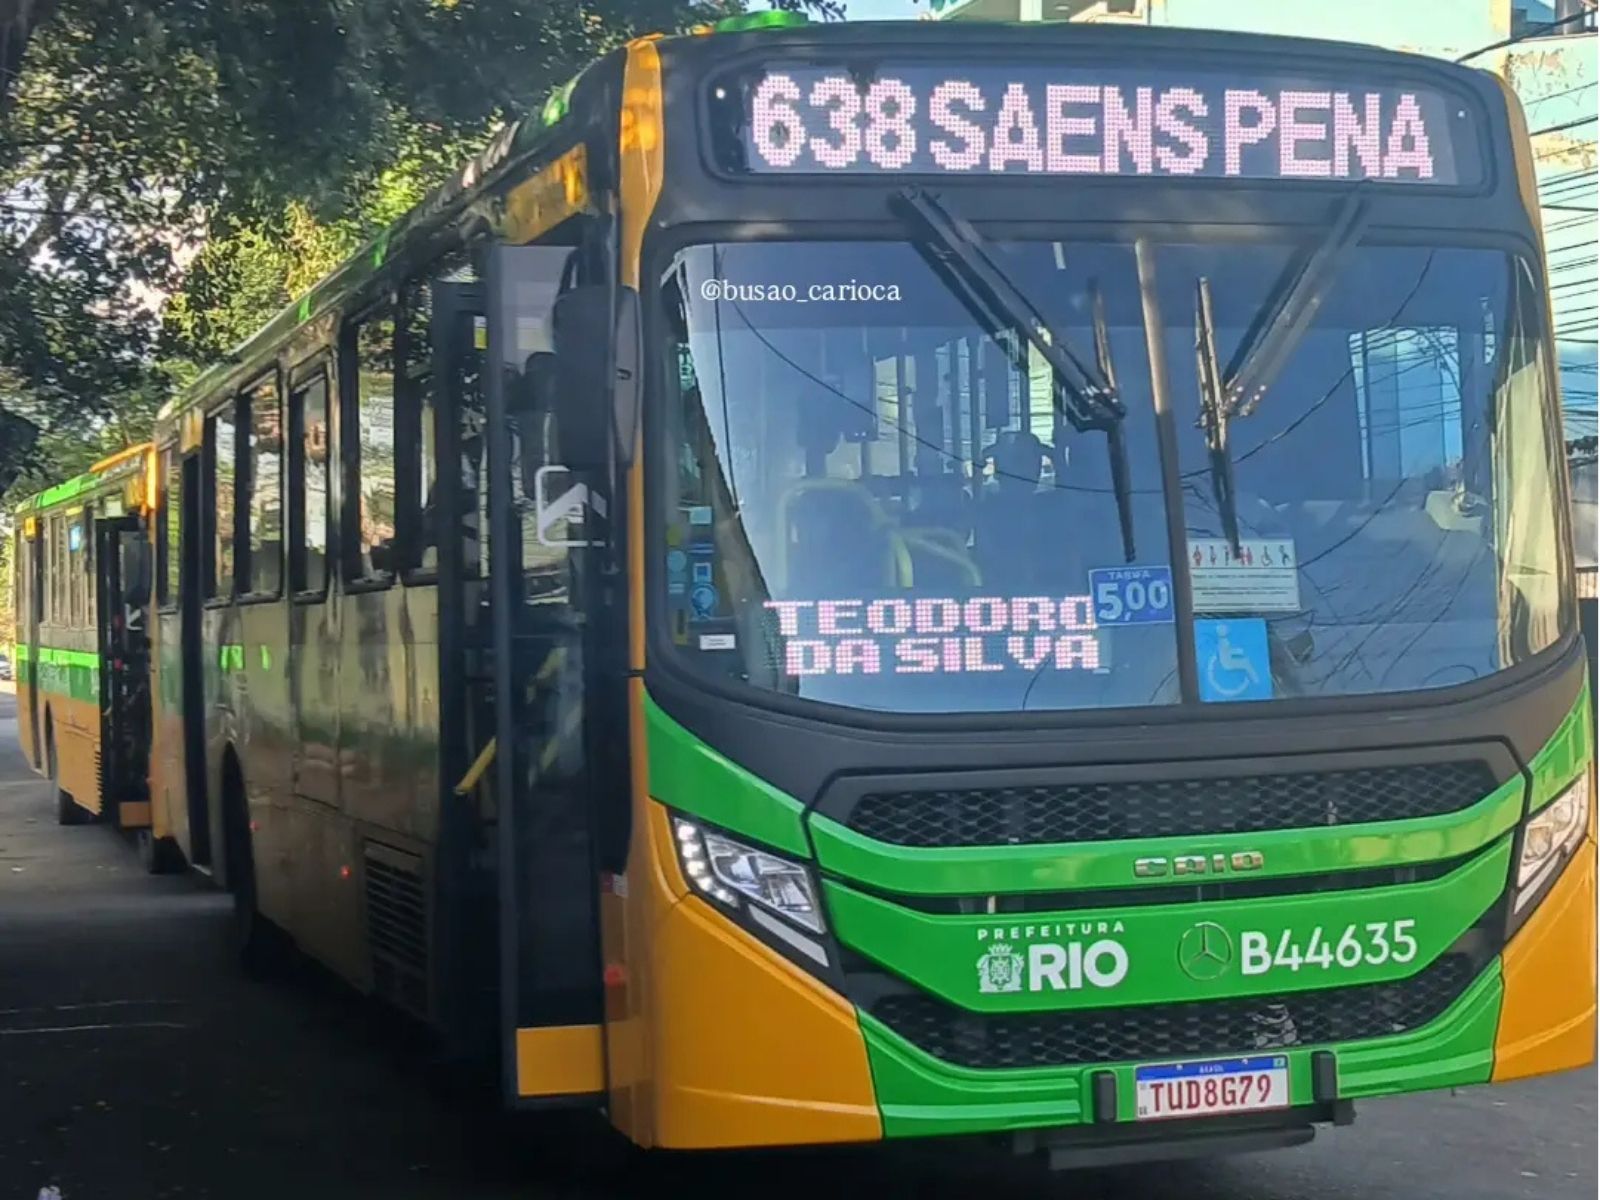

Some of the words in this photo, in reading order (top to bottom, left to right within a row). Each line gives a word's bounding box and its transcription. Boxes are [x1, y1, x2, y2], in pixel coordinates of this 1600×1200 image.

[752, 75, 916, 168] 638
[929, 80, 1209, 175] SAENS
[1223, 89, 1434, 179] PENA
[1097, 580, 1168, 622] 5,00
[786, 639, 881, 675] DA
[895, 635, 1100, 673] SILVA
[1135, 851, 1264, 877] CAIO
[977, 921, 1125, 941] PREFEITURA
[1241, 919, 1418, 975] B44635
[1028, 939, 1129, 991] RIO
[1150, 1074, 1272, 1112] TUD8G79
